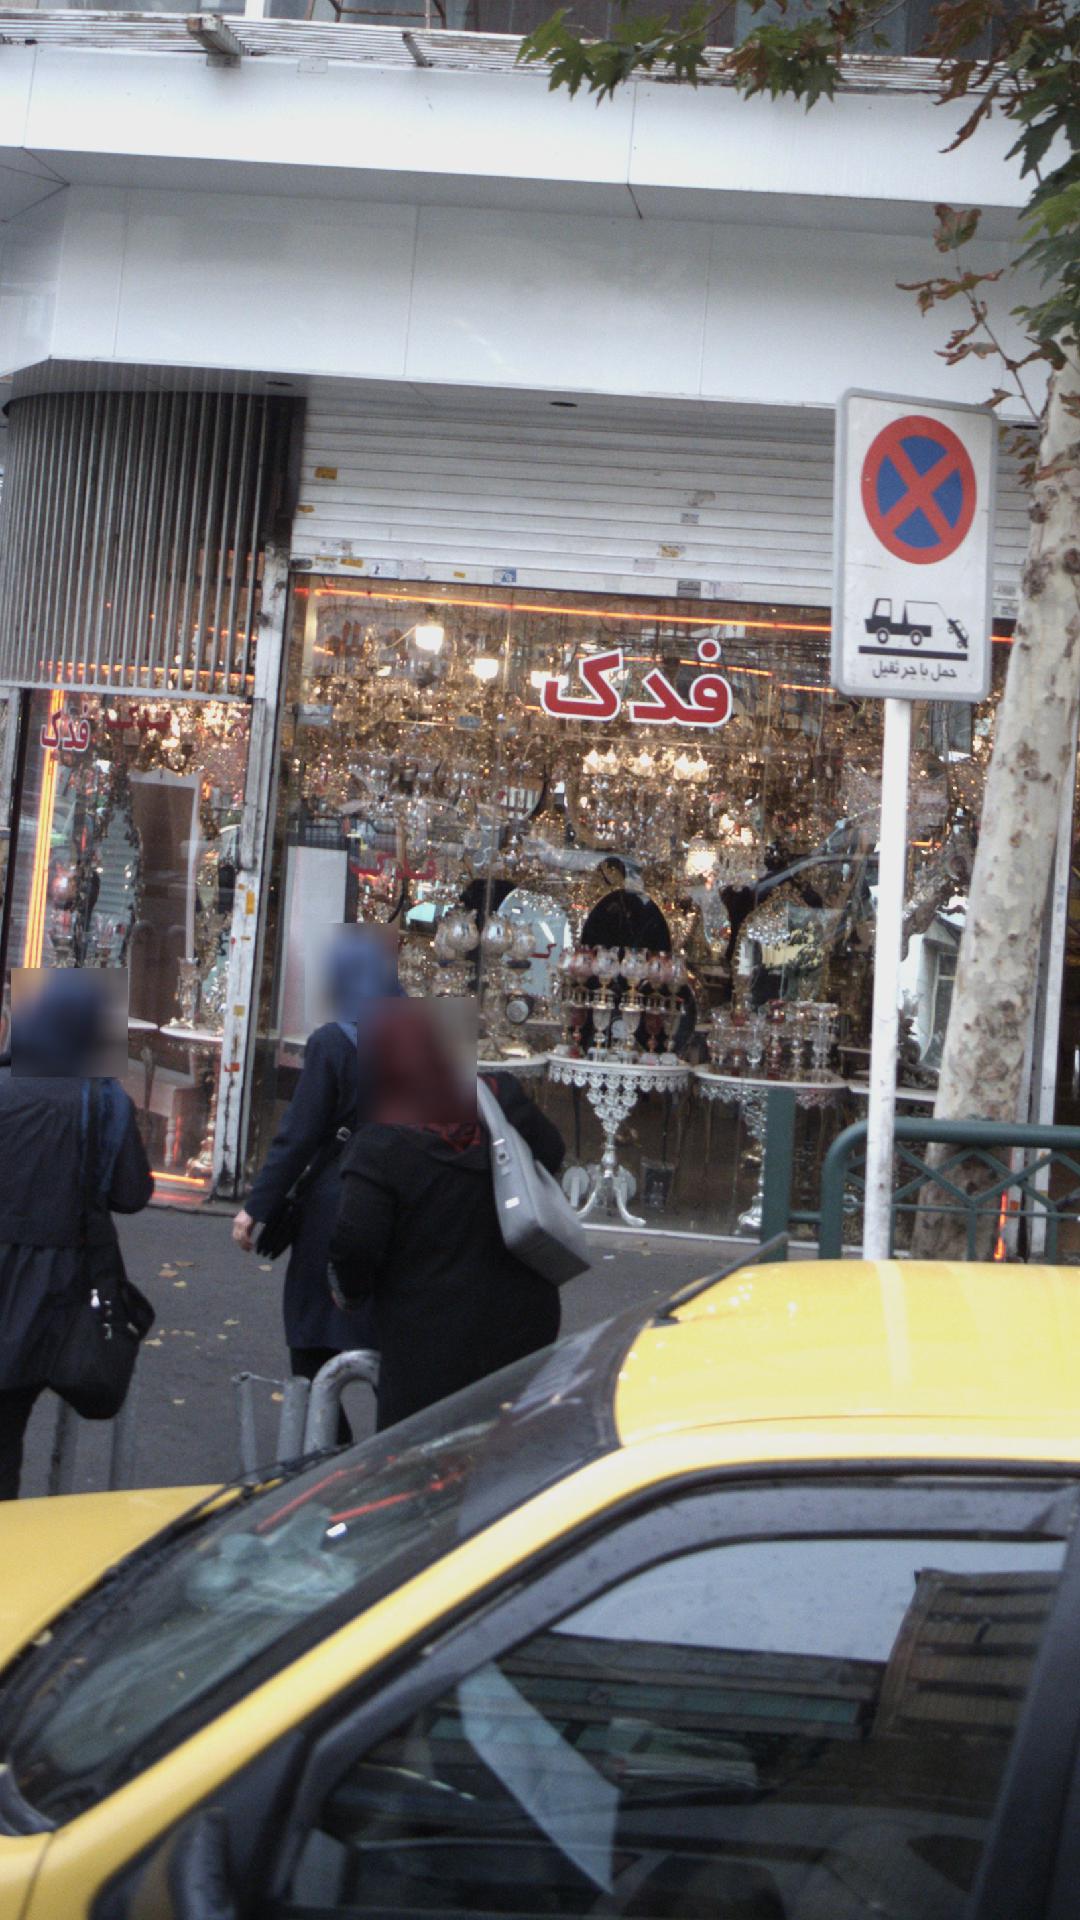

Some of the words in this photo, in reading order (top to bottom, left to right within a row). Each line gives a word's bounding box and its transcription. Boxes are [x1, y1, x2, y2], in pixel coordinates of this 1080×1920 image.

[540, 639, 733, 728] فدک
[919, 662, 929, 680] با
[931, 663, 958, 682] حمل
[40, 703, 90, 752] فدک
